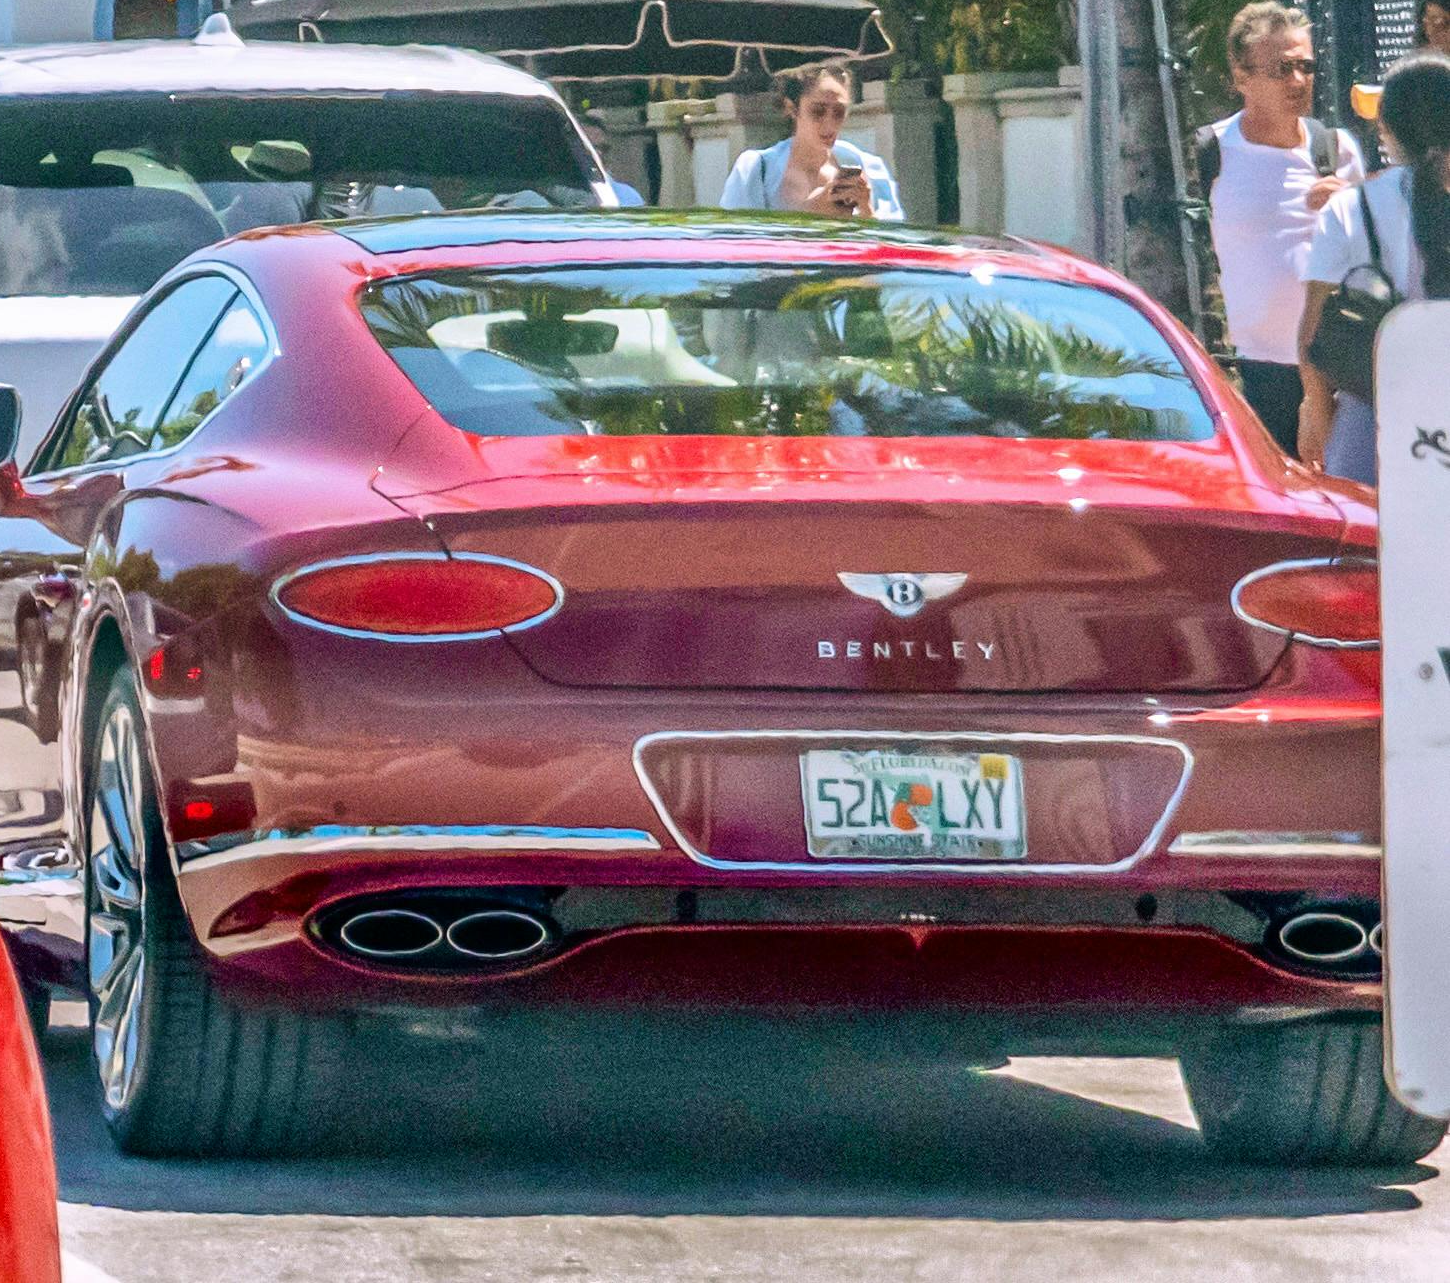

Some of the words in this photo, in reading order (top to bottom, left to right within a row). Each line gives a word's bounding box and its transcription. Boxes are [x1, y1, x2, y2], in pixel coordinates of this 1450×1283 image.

[817, 641, 996, 660] BENTLEY
[817, 778, 891, 828] 52A
[936, 779, 1005, 829] LXY
